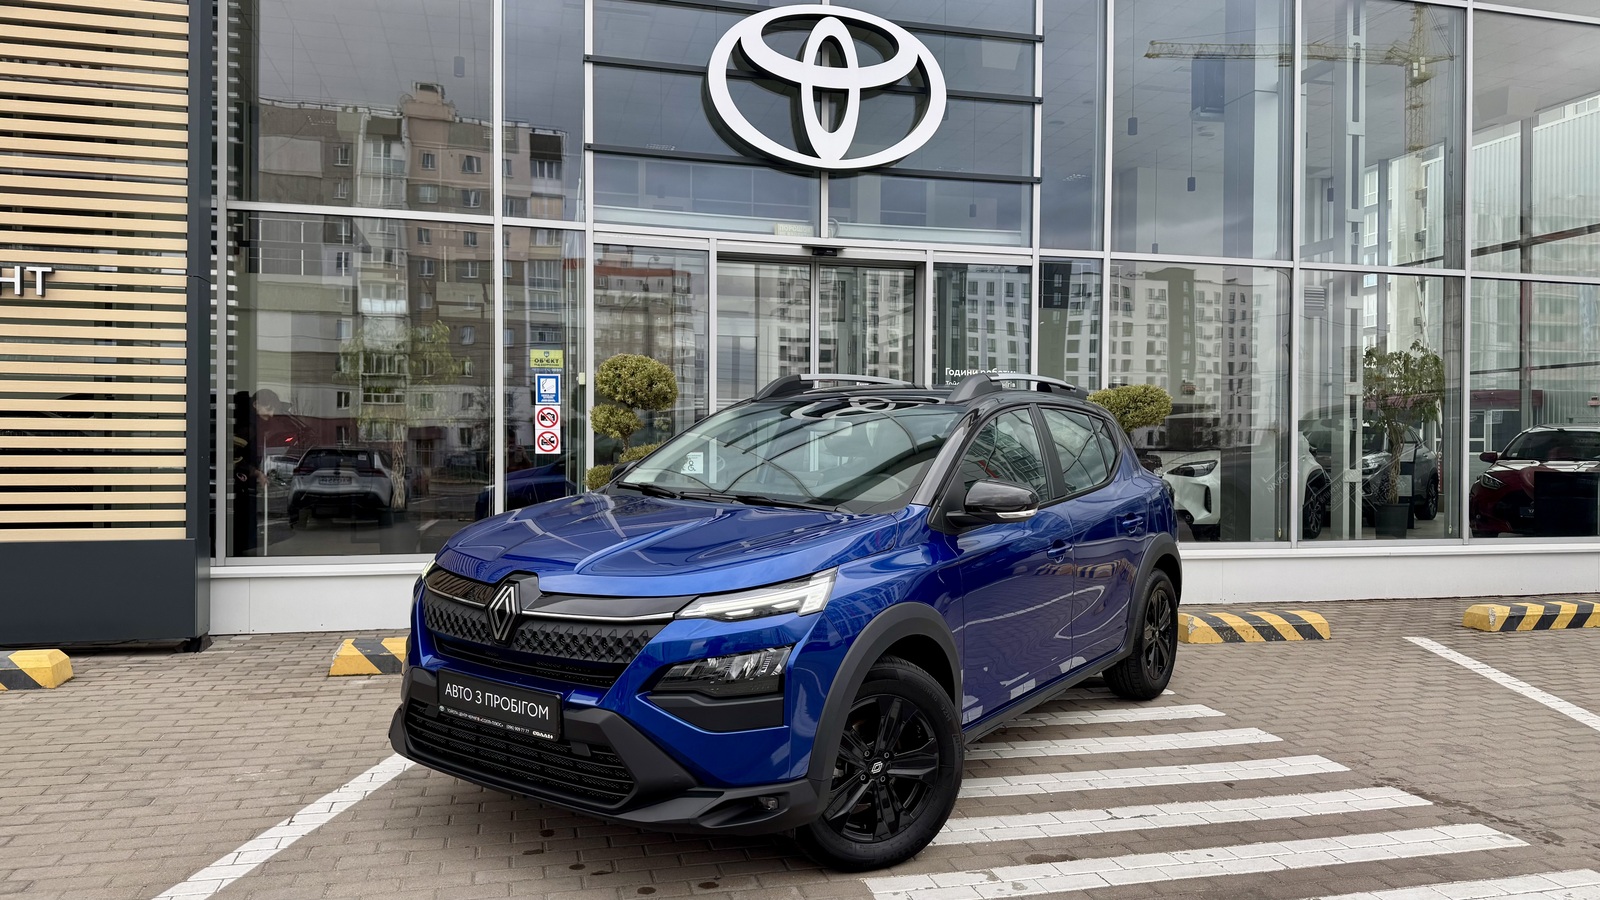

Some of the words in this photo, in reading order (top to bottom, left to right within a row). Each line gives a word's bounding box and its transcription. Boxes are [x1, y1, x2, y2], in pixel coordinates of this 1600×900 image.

[945, 368, 978, 376] Години
[444, 682, 472, 701] АВТО
[486, 692, 548, 720] ПРОБІГОМ
